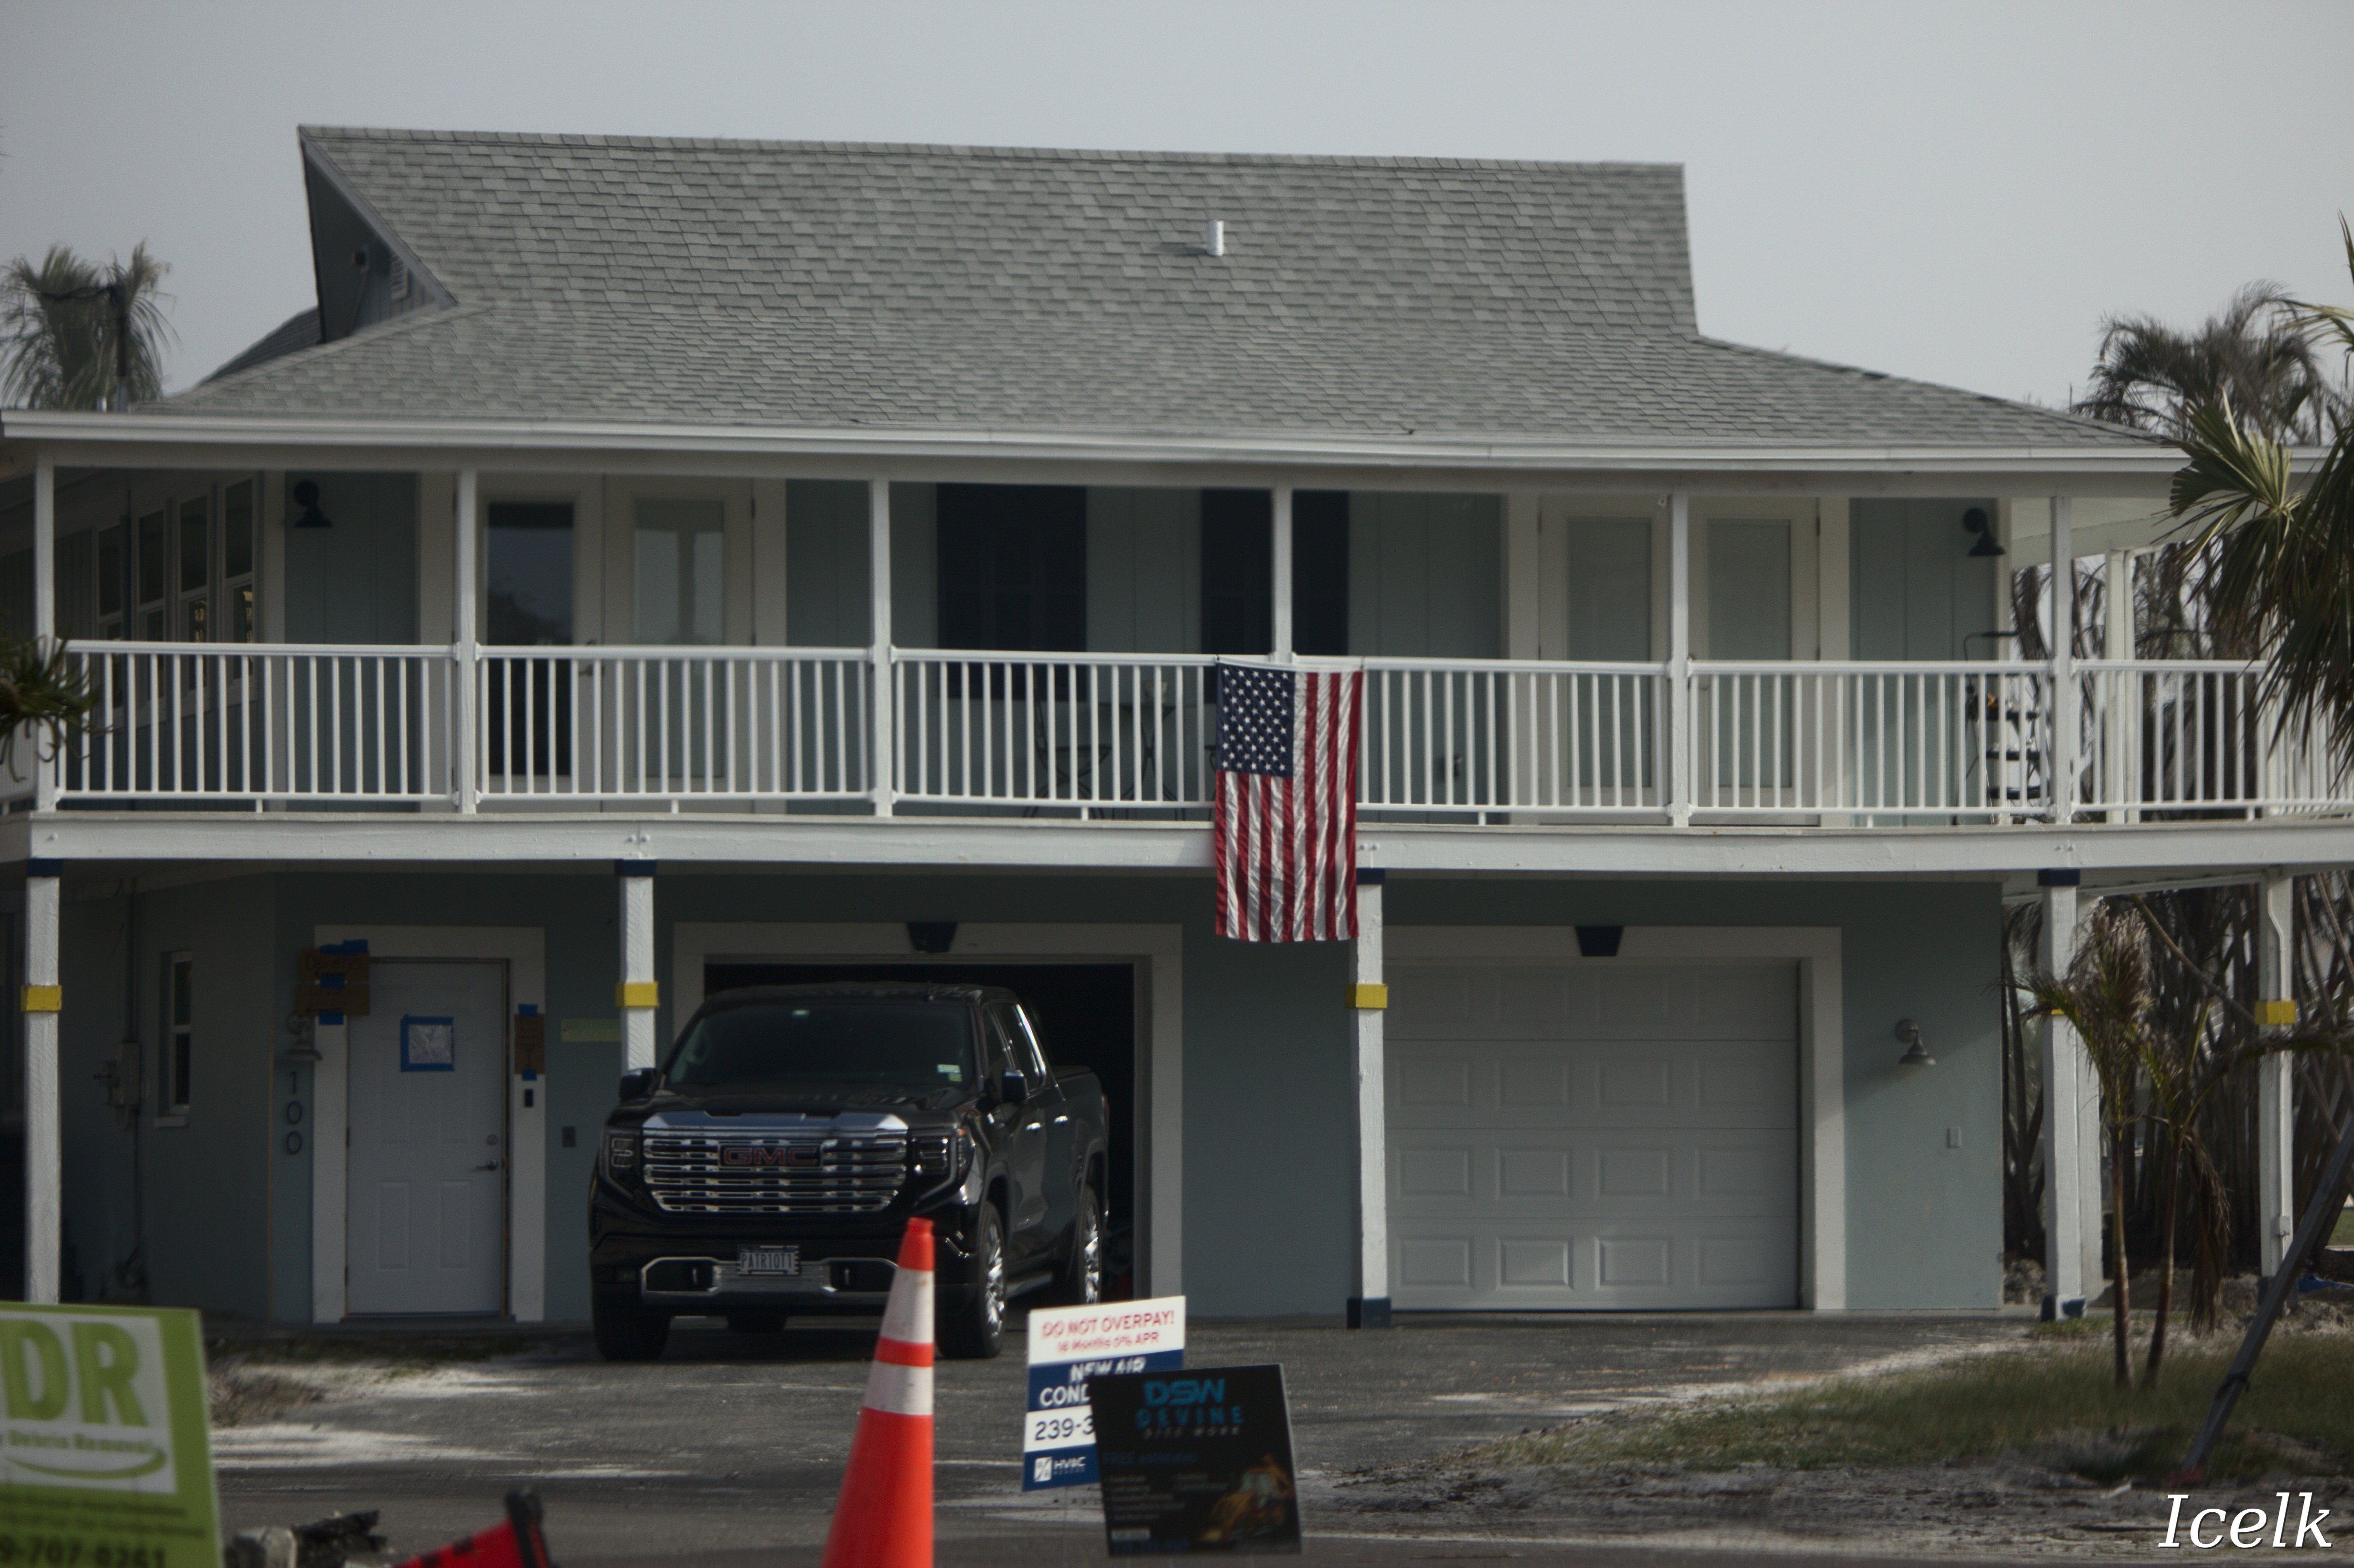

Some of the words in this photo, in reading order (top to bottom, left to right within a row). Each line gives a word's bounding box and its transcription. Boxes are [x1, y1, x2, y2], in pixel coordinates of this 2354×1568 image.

[724, 1148, 817, 1164] GMC
[1042, 1321, 1065, 1339] DO
[1068, 1316, 1098, 1335] NOT
[1101, 1310, 1175, 1332] OVERPAY!
[1135, 1332, 1160, 1346] APR
[1, 1319, 150, 1428] DR
[1143, 1379, 1225, 1407] DSW
[1135, 1406, 1243, 1429] DEVINE
